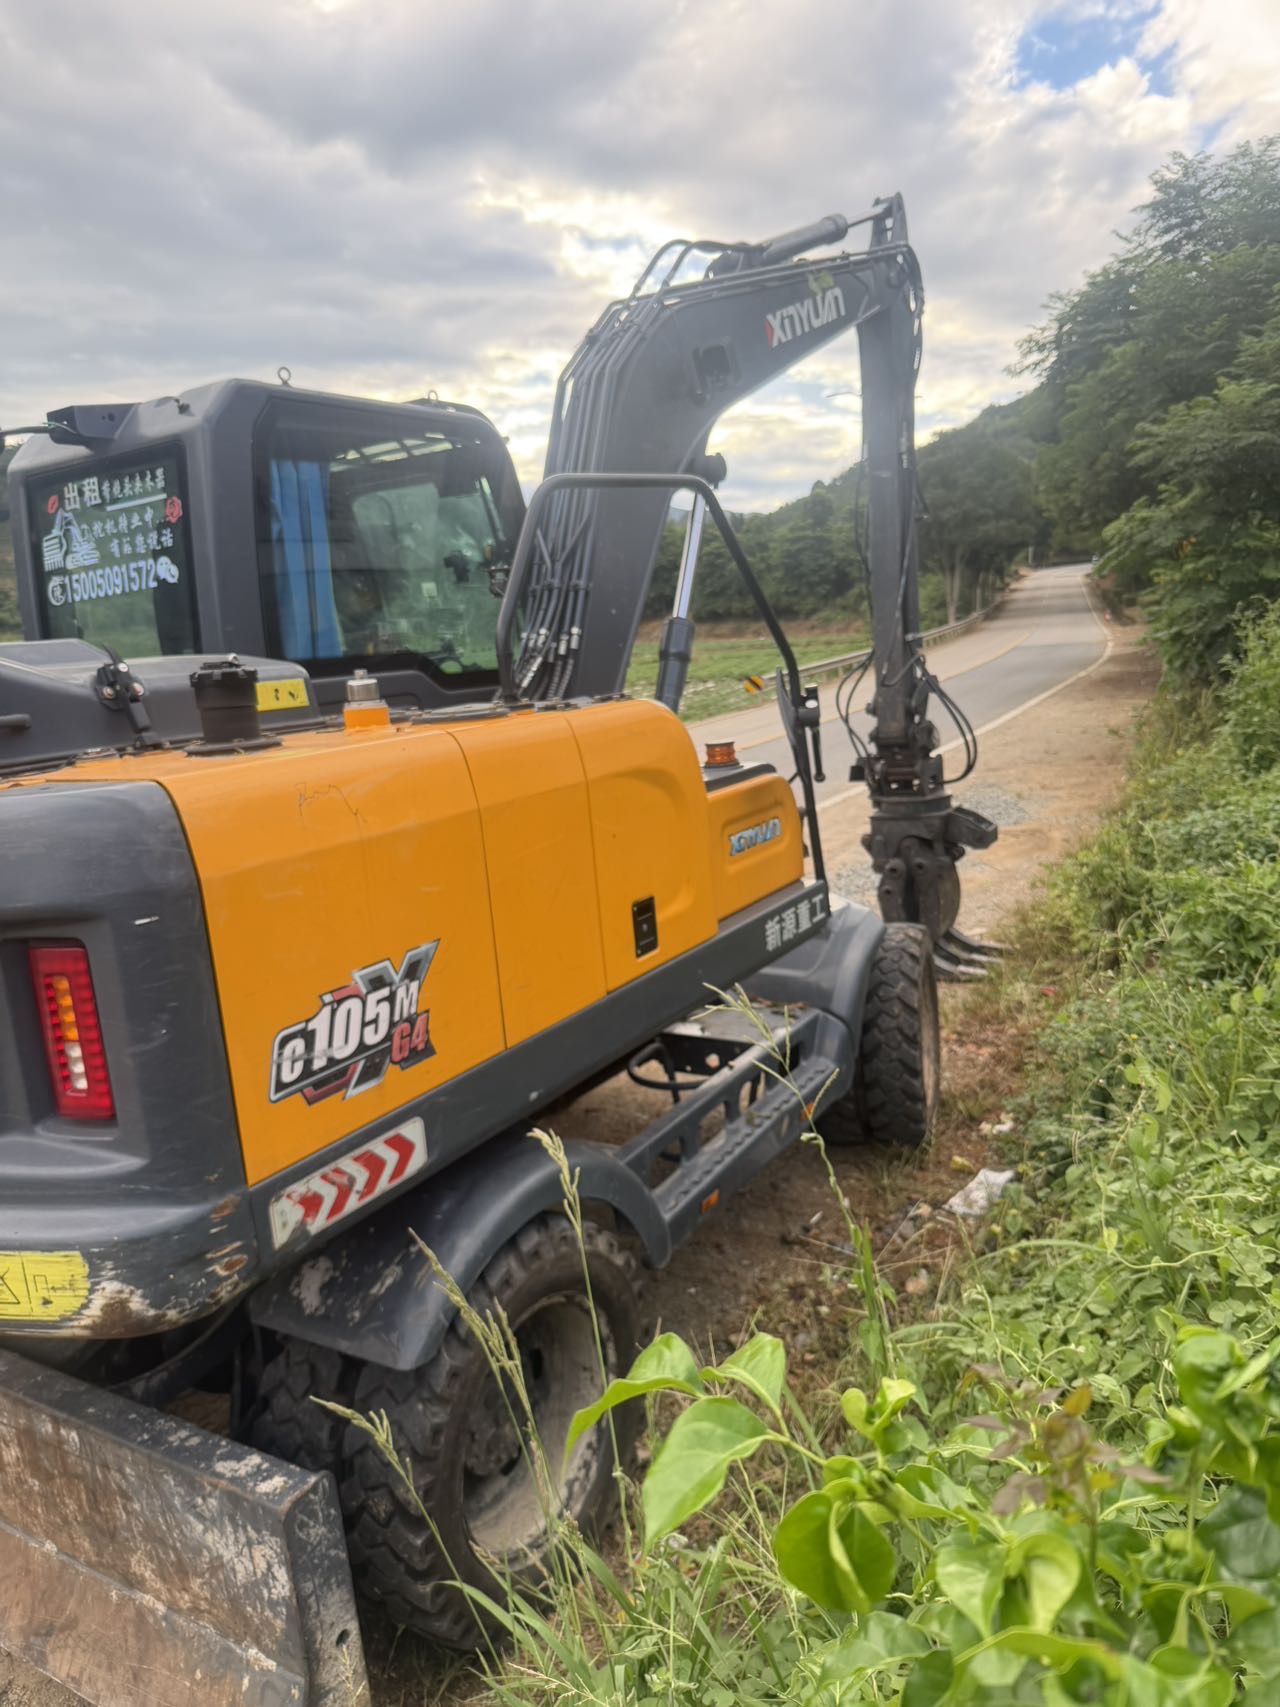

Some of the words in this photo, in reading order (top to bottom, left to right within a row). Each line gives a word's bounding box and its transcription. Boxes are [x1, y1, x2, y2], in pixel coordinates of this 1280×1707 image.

[63, 476, 102, 511] 出租
[64, 558, 158, 603] 15005091572
[765, 893, 826, 952] 新源重工
[390, 1011, 429, 1063] G4
